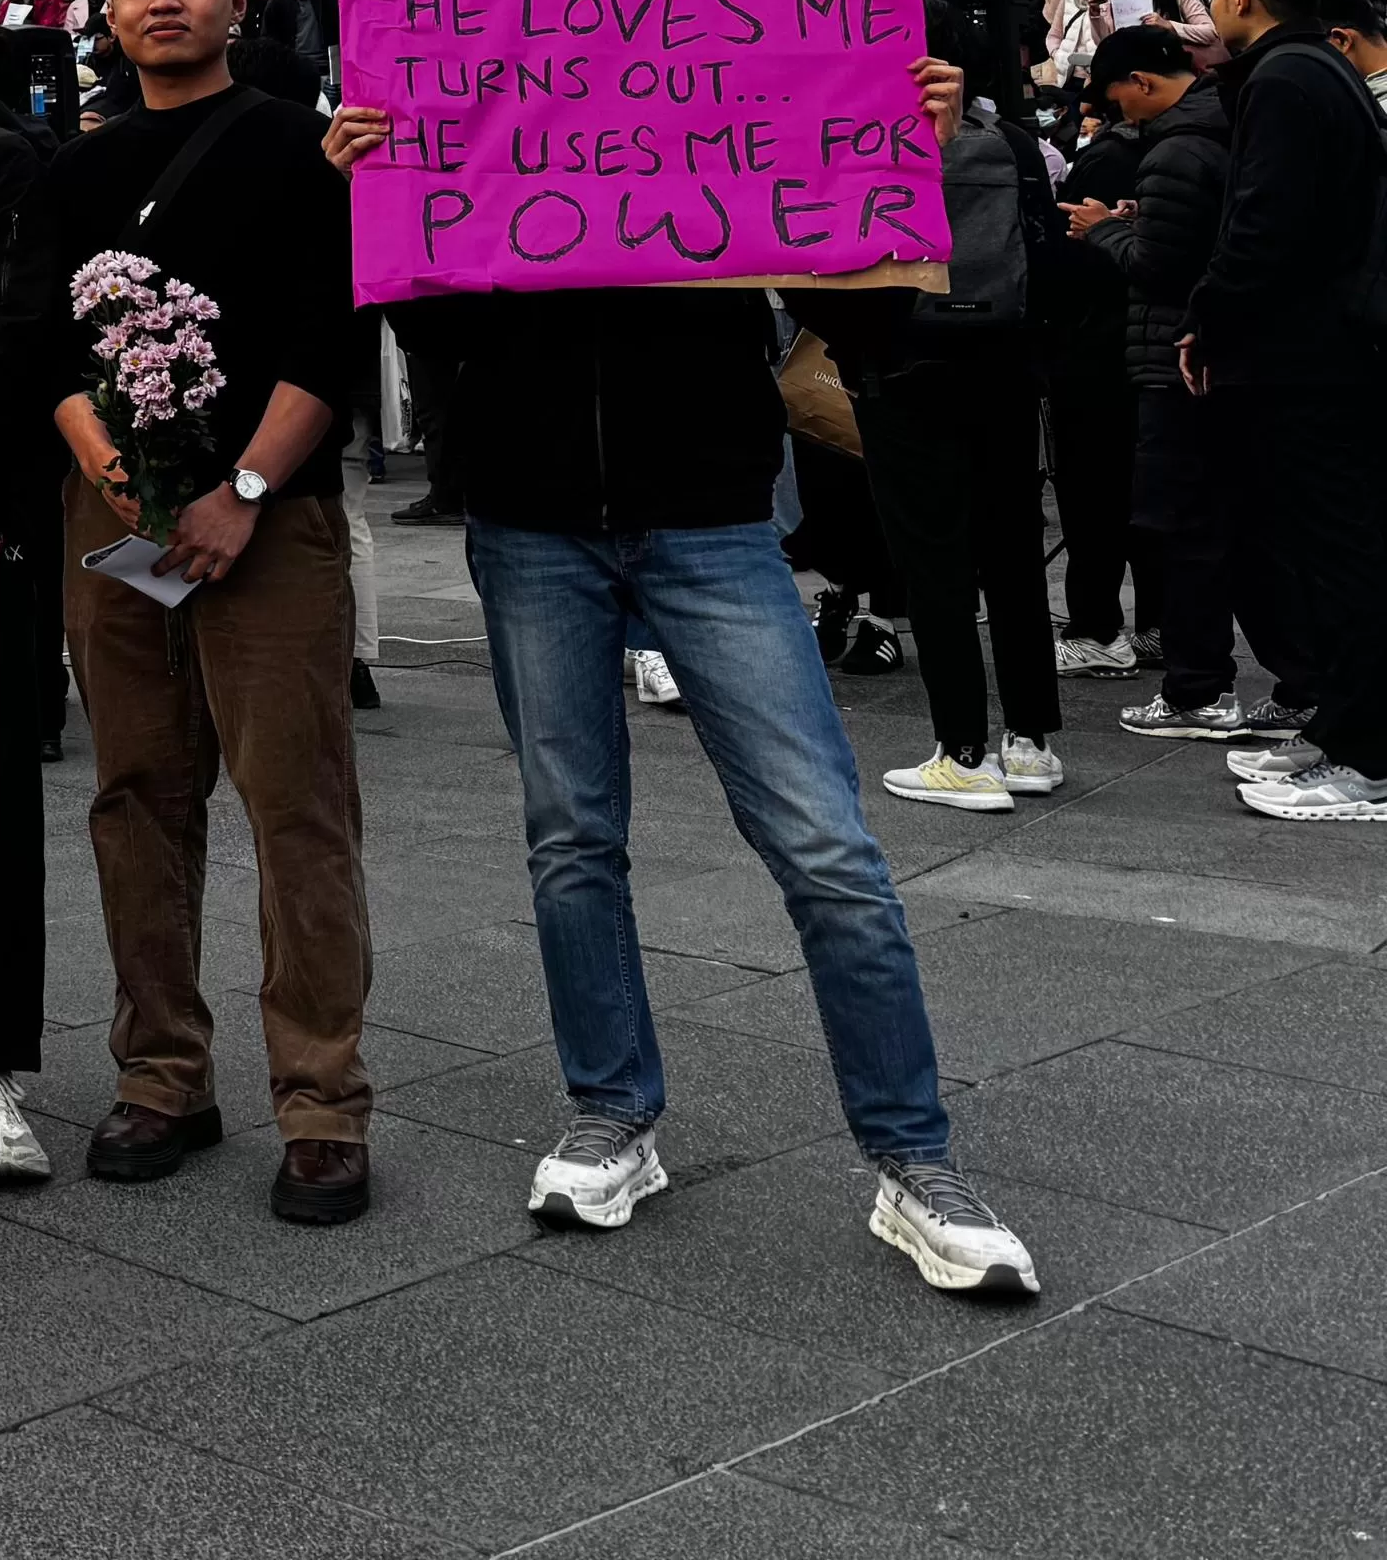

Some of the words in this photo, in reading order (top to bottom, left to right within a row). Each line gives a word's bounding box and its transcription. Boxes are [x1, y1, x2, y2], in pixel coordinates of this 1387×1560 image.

[394, 56, 589, 104] TURNS
[388, 119, 469, 173] HE
[511, 124, 664, 177] USES
[685, 120, 779, 177] ME
[820, 115, 932, 168] FOR
[421, 179, 938, 266] POWER
